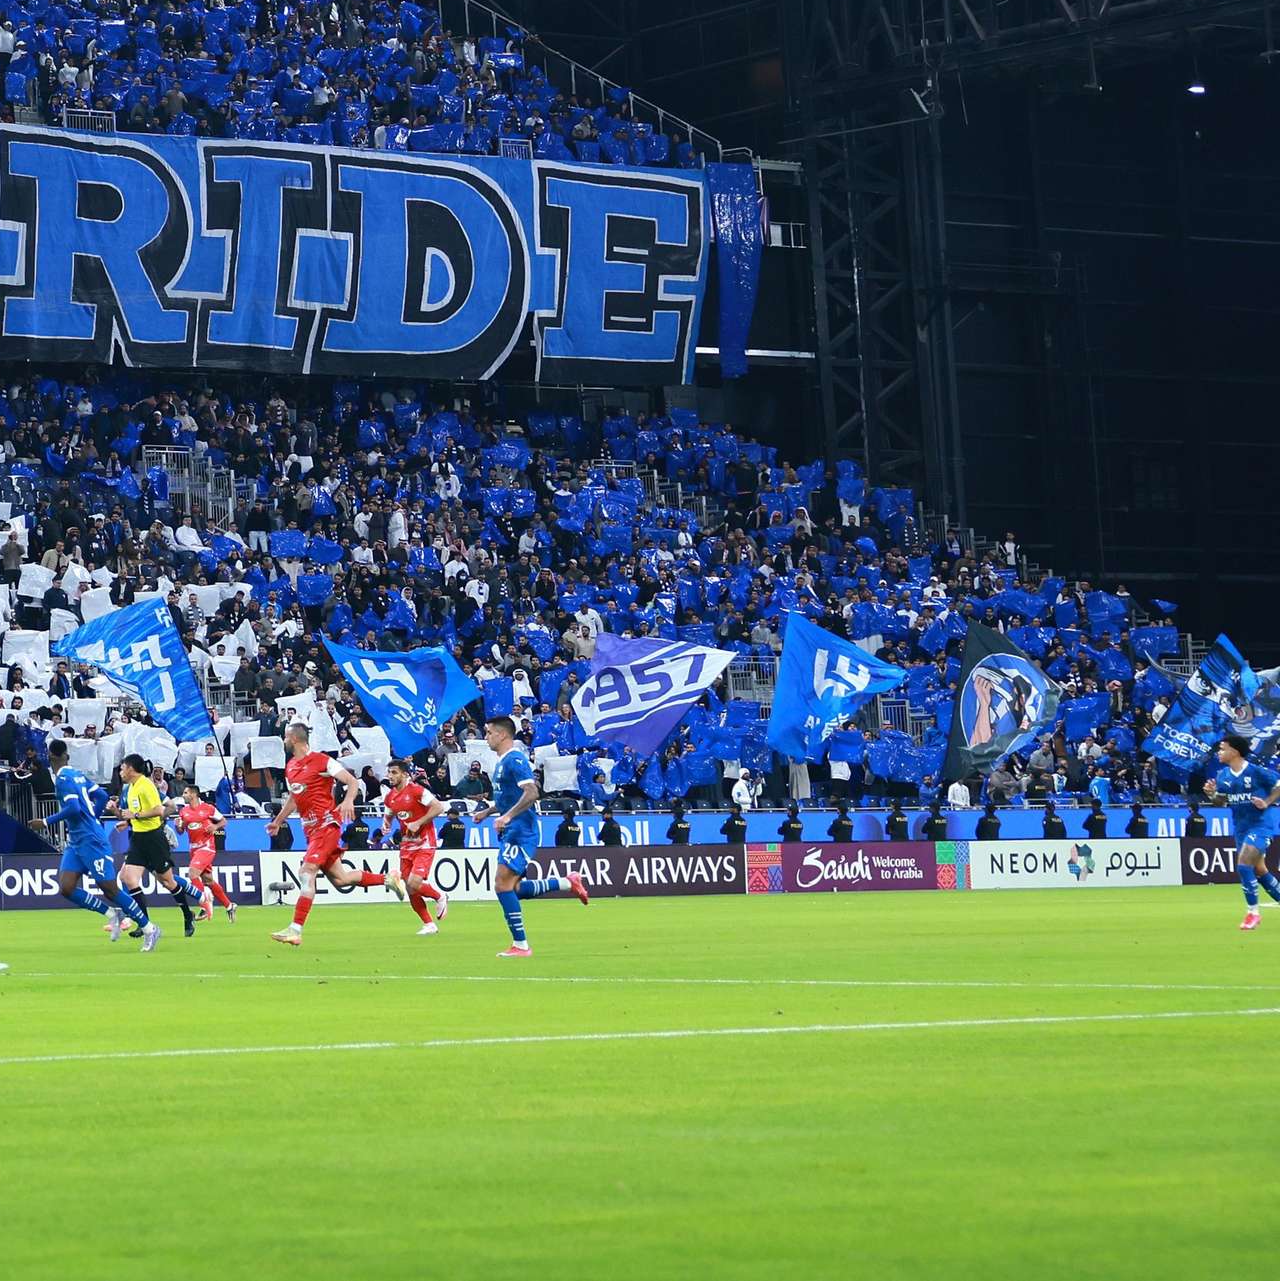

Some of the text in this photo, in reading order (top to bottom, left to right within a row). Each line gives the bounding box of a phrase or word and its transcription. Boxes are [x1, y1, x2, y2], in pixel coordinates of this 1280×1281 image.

[502, 842, 519, 859] 20
[872, 855, 916, 867] Welcome
[1105, 846, 1161, 877] نيوم
[1189, 847, 1237, 876] QAT
[93, 858, 105, 872] 87
[624, 855, 737, 885] AIRWAYS
[796, 847, 873, 888] Saudi
[880, 867, 923, 879] to Arabia
[990, 852, 1058, 874] NEOM
